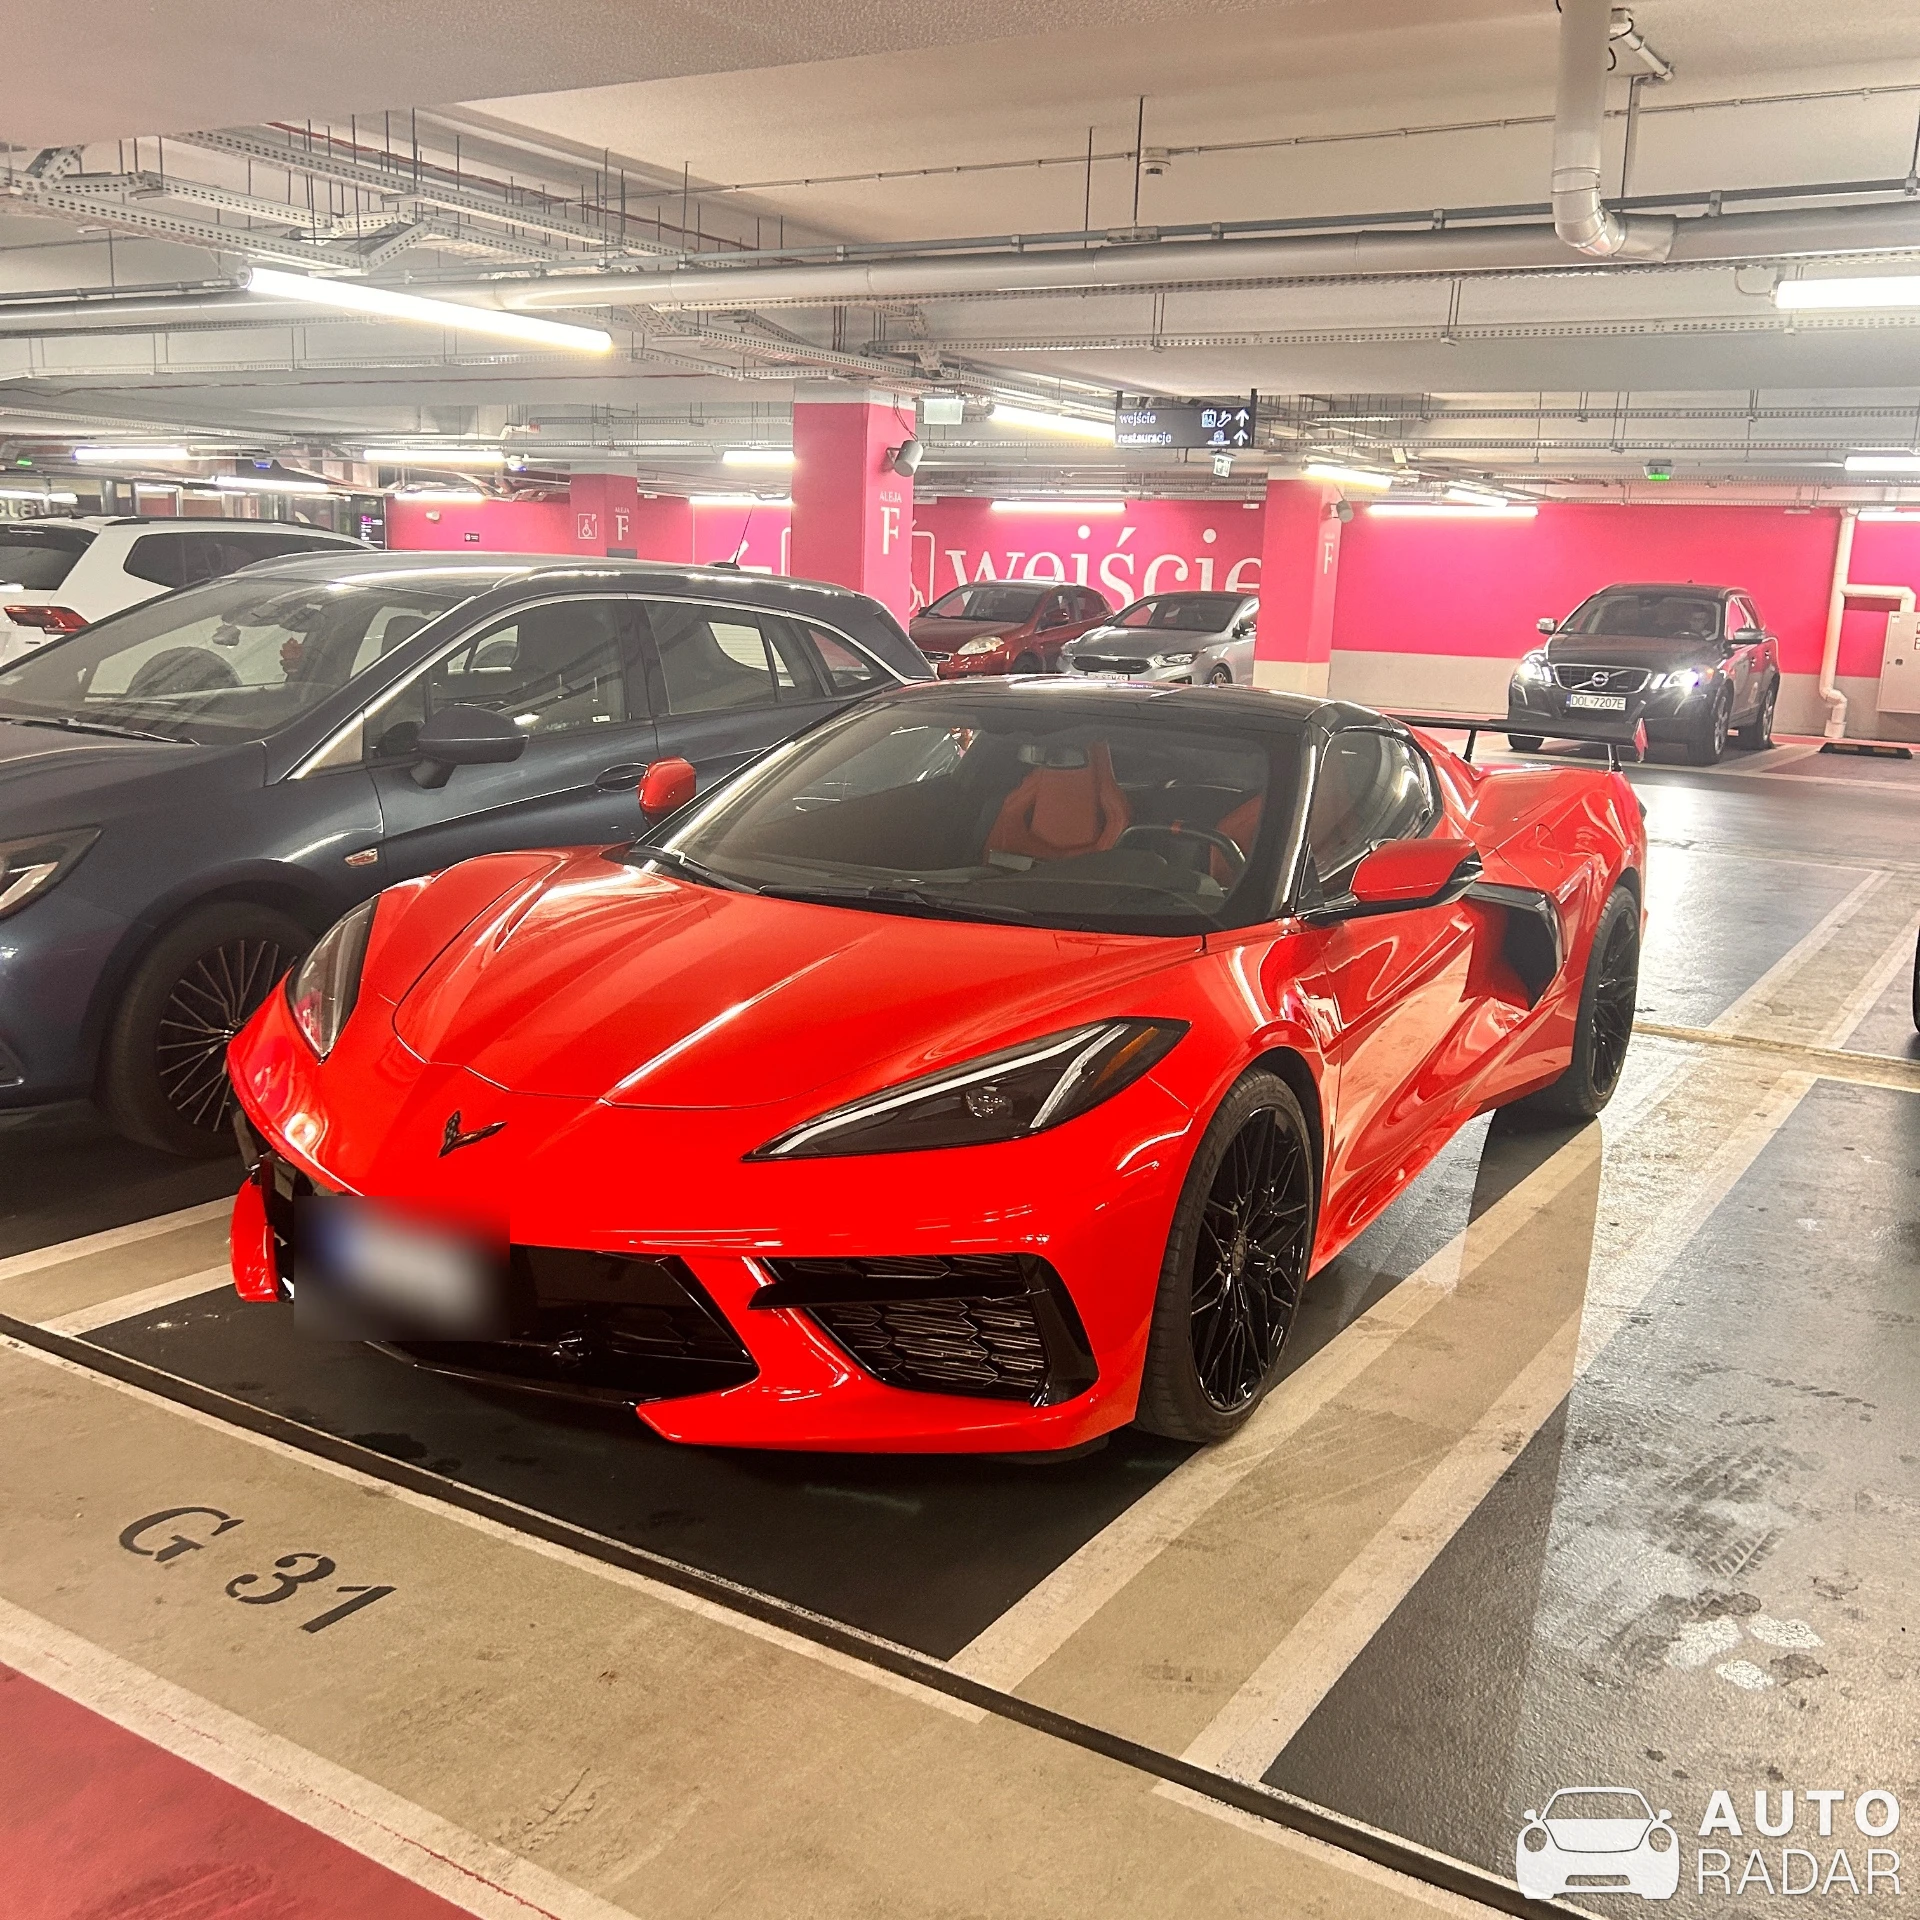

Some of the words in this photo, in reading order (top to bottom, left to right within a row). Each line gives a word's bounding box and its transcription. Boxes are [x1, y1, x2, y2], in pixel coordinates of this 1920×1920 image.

[1119, 411, 1156, 426] wejście
[1118, 432, 1172, 446] restauracje
[880, 491, 902, 503] ALEJA
[615, 514, 629, 541] F
[880, 506, 900, 555] F
[1323, 542, 1334, 574] F
[1571, 695, 1590, 707] DOL
[1593, 697, 1625, 709] 7207E
[118, 1506, 245, 1563] G
[224, 1552, 398, 1634] 31
